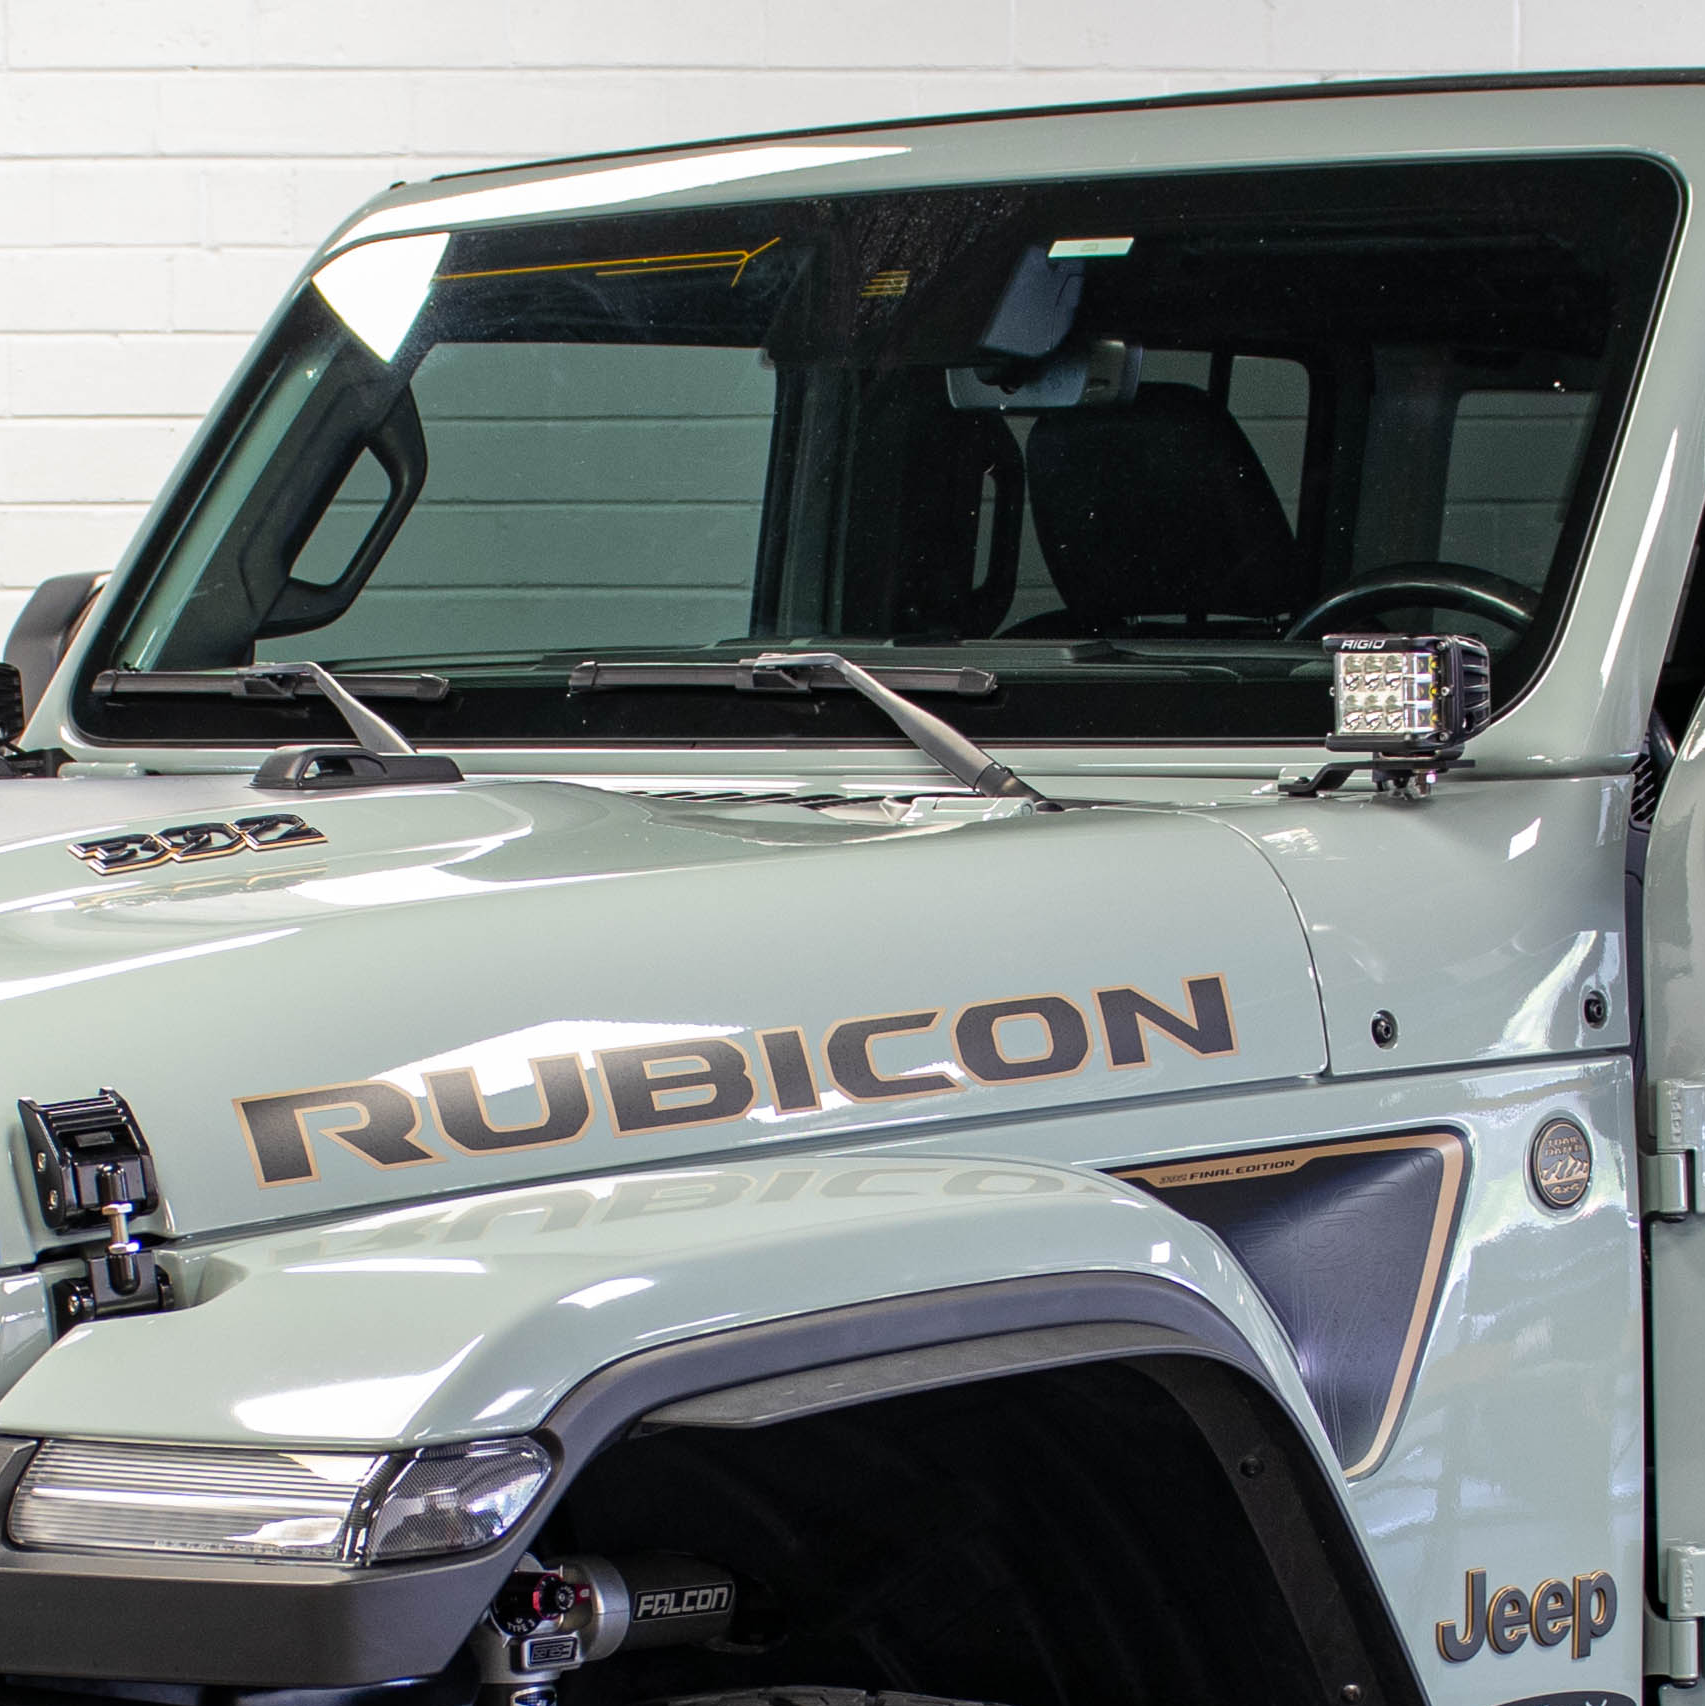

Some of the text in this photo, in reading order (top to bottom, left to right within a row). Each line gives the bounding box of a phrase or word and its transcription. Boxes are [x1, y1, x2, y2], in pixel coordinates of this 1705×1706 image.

[1341, 639, 1386, 650] RIGID
[232, 972, 1241, 1190] RUBICON
[1189, 1167, 1235, 1180] FINAL
[1235, 1159, 1295, 1174] EDITION
[636, 1586, 729, 1618] FALCON
[1435, 1567, 1618, 1663] Jeep
